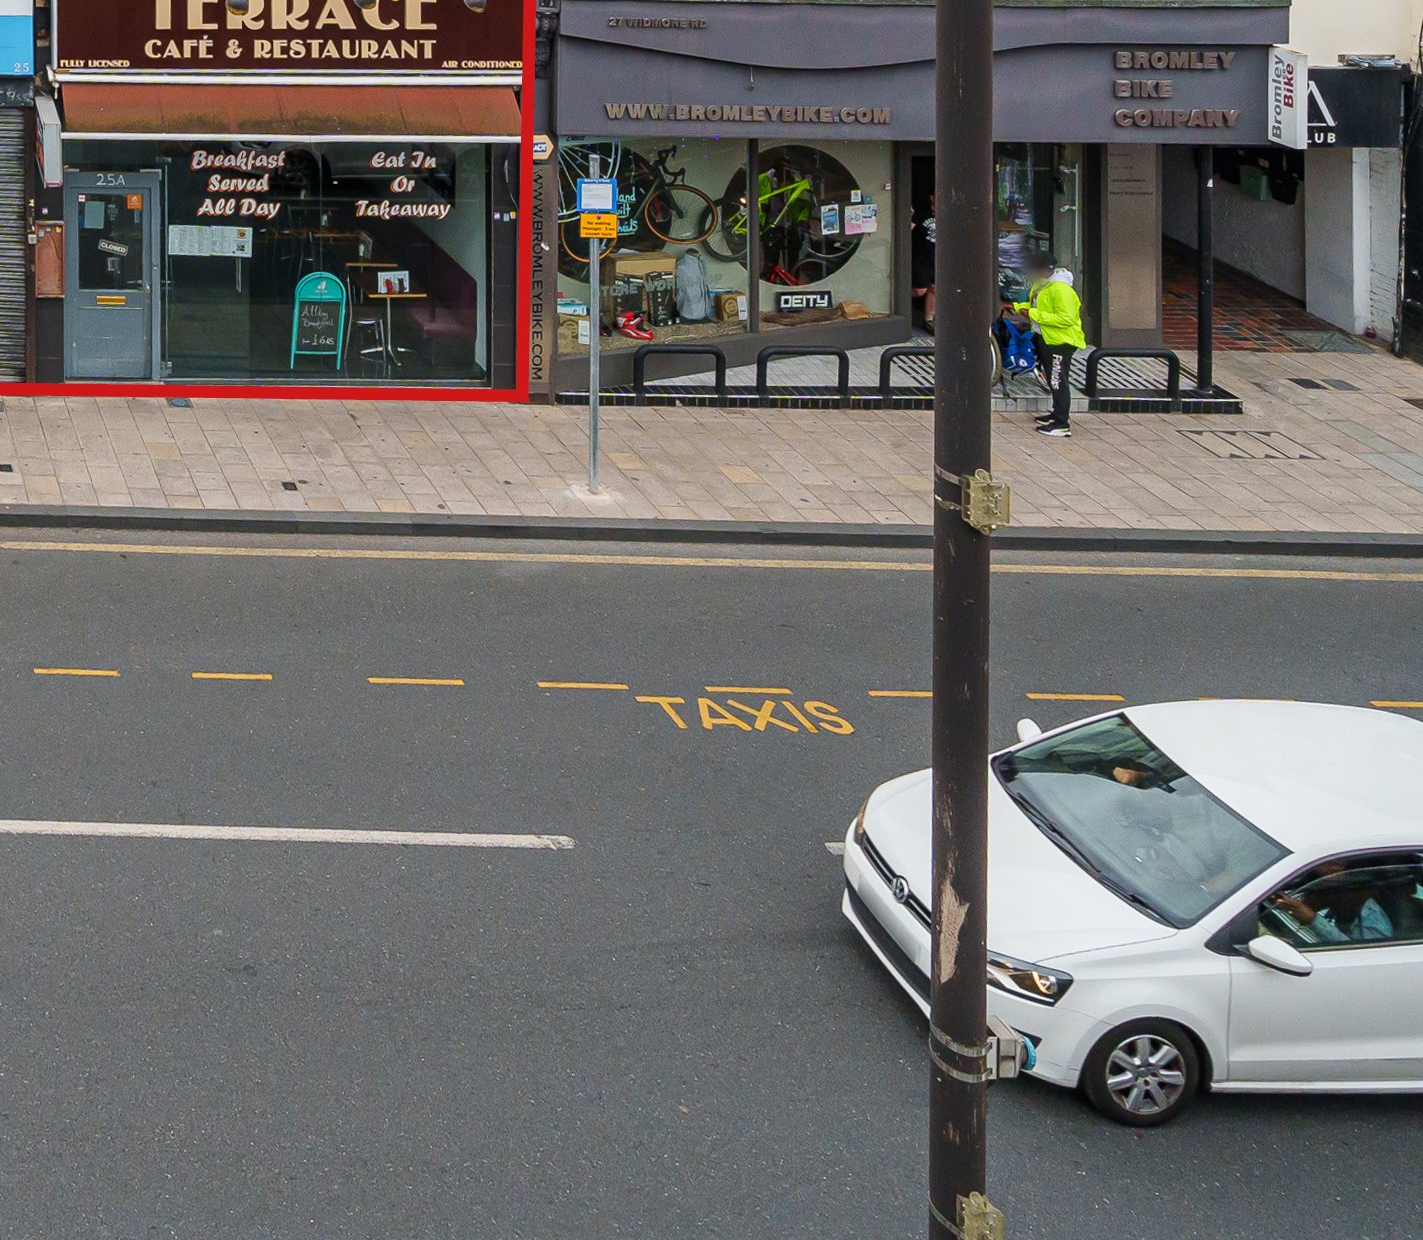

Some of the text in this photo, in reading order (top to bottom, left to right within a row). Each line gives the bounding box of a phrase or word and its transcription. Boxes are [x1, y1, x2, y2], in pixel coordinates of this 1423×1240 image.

[608, 16, 623, 28] 27
[144, 35, 437, 59] CAFÉ & RESTAURANT
[13, 62, 30, 73] 25
[60, 60, 130, 68] FULLY LICENSED
[441, 60, 523, 69] AIR CONDITIONED
[1115, 50, 1236, 70] BROMLEY
[1114, 79, 1173, 98] BIKE
[1283, 63, 1294, 108] Bike
[1272, 55, 1284, 140] Bromley
[604, 103, 892, 124] WWW.BROMLEYBIKE.COM
[1115, 108, 1239, 128] COMPANY
[190, 150, 286, 172] Breakfast
[369, 151, 437, 168] Eat In
[96, 174, 126, 186] 25A
[207, 174, 269, 192] Served
[389, 175, 415, 193] Or
[197, 198, 281, 220] All Day
[355, 200, 451, 220] Takeaway
[100, 241, 127, 254] CLOSED
[531, 168, 543, 380] WWW.BROMLEYBIKE.COM
[780, 295, 829, 308] DEITY
[634, 696, 855, 735] TAXIS
